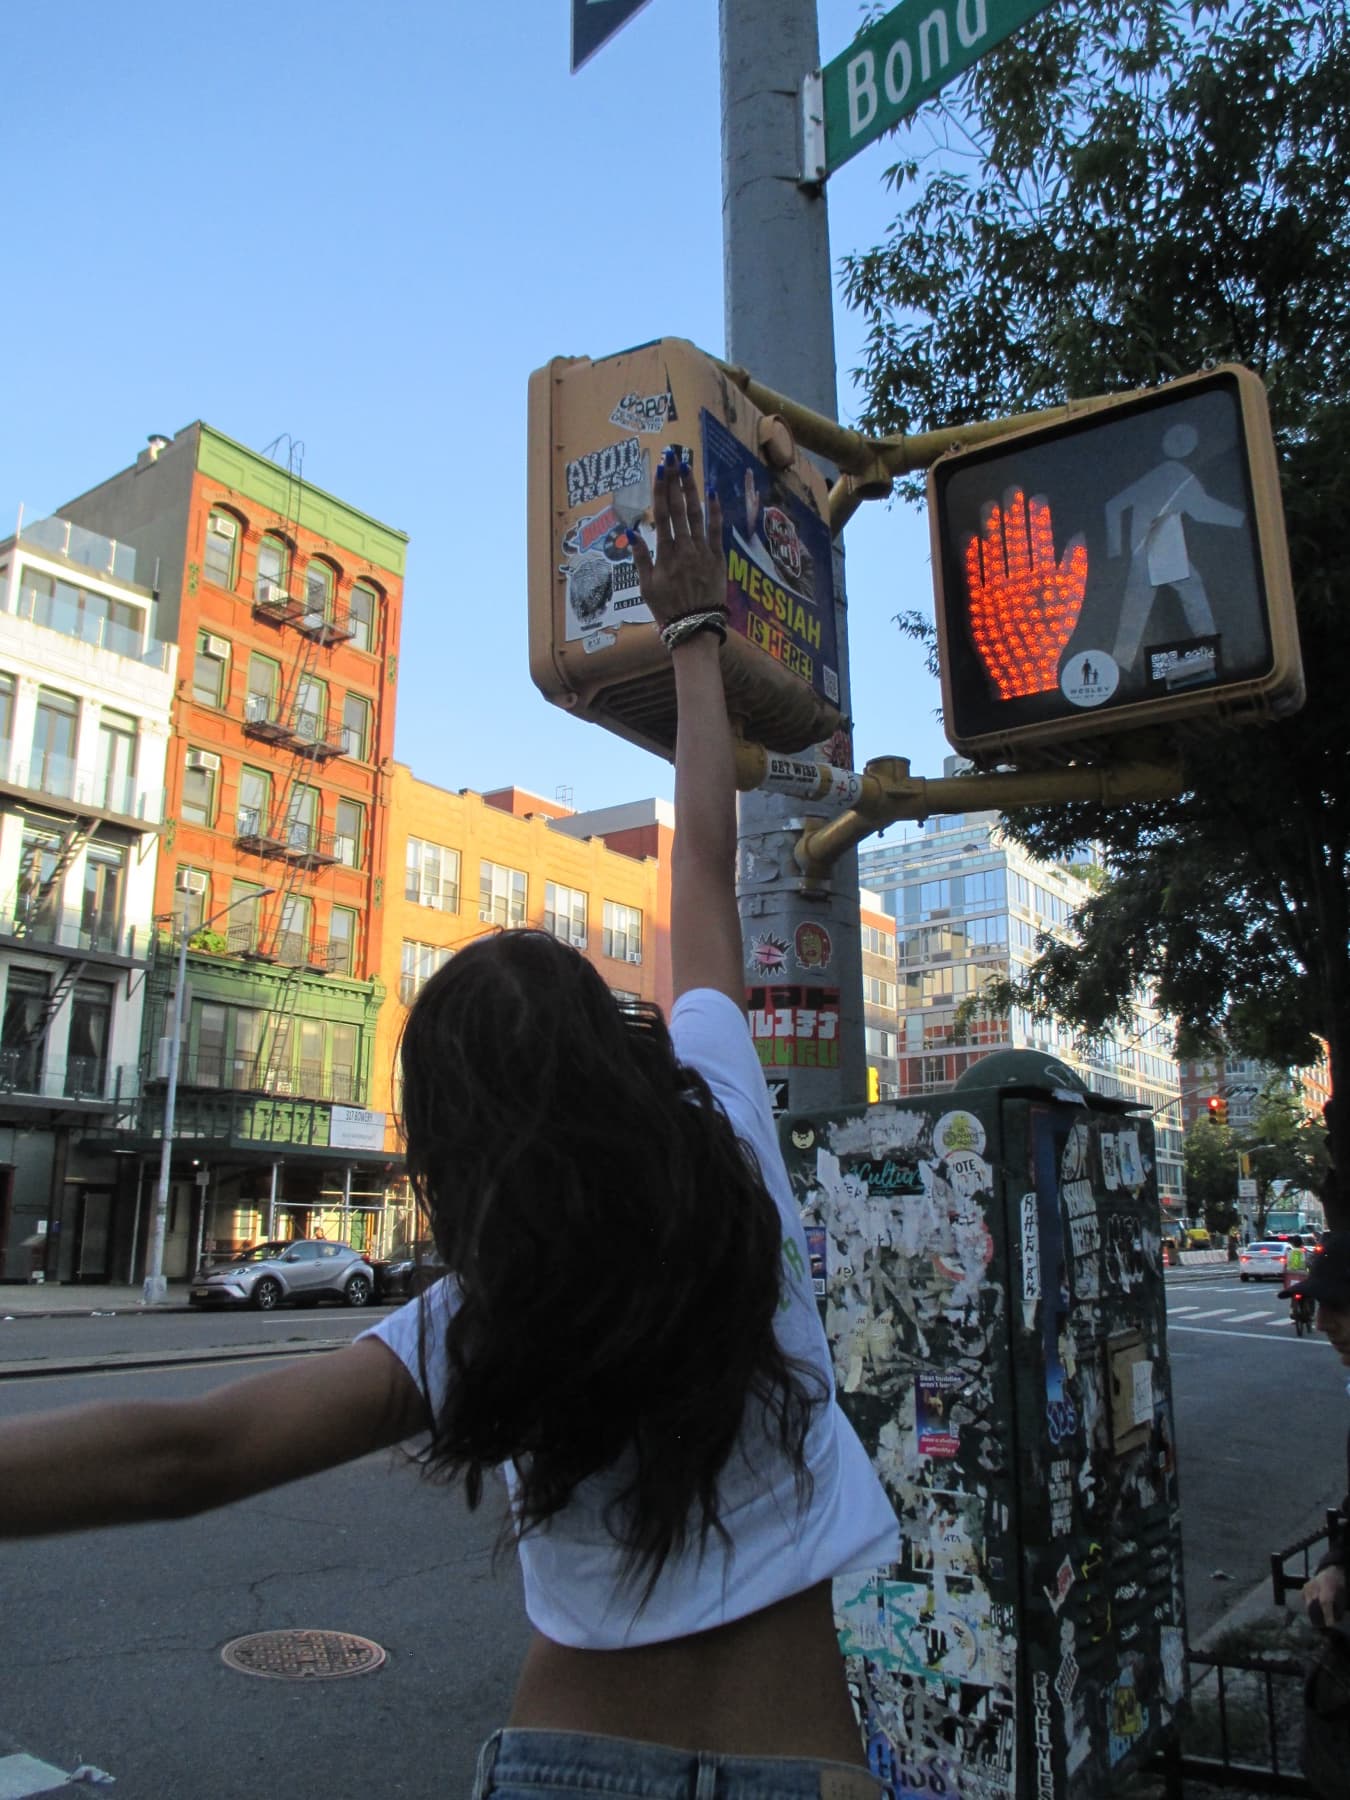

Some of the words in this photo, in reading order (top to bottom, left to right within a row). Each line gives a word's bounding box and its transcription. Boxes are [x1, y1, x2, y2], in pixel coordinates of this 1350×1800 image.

[728, 550, 821, 650] MESSIAH
[749, 613, 766, 647] IS
[768, 625, 813, 683] HERE!
[771, 760, 791, 775] GET
[793, 762, 818, 778] WISE
[953, 1159, 977, 1174] OTE
